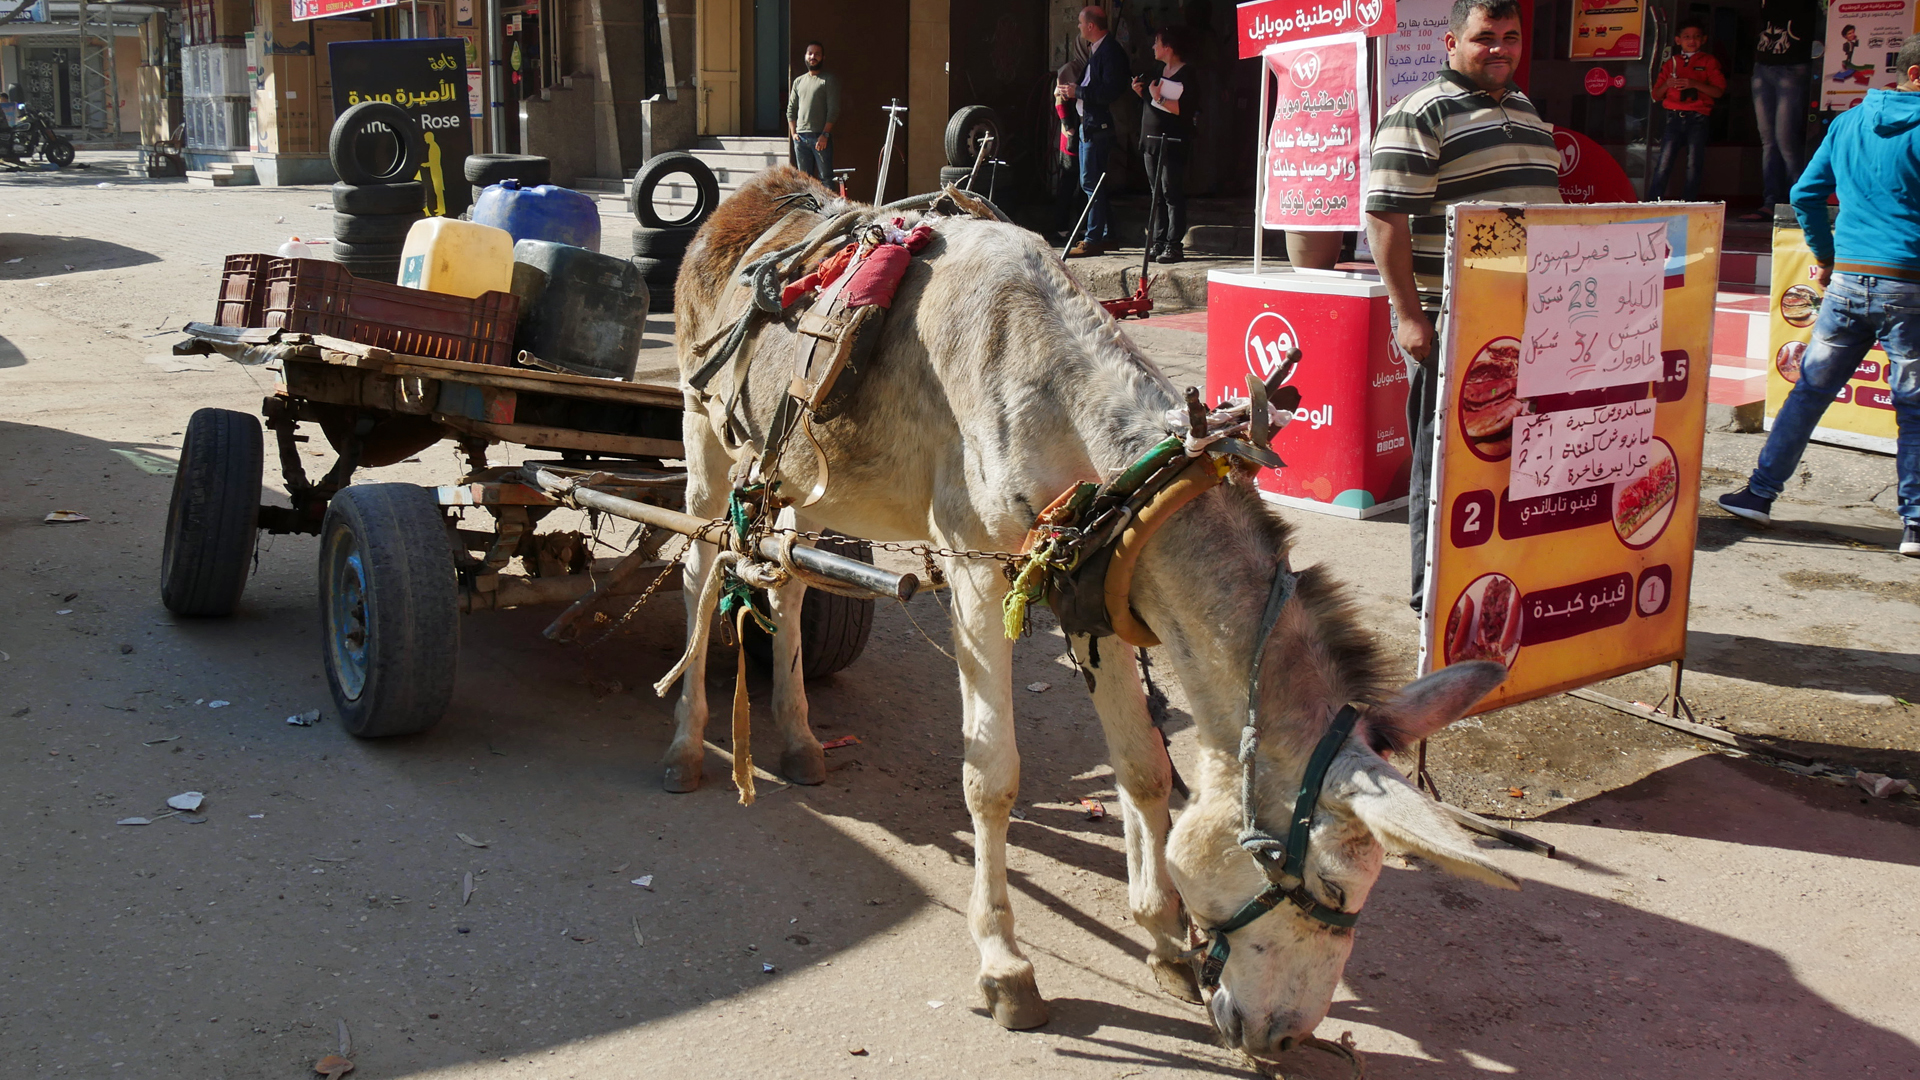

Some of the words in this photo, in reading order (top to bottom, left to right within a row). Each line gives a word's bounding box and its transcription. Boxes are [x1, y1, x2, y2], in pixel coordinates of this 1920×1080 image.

[1248, 15, 1294, 40] موبايل
[1296, 0, 1350, 32] الوطنية
[1409, 19, 1420, 28] بها
[1422, 16, 1448, 27] شريحة
[1400, 30, 1412, 38] MB
[1418, 29, 1432, 37] 100
[1388, 55, 1412, 66] هدية
[1396, 44, 1410, 52] SMS
[1414, 54, 1436, 66] على
[428, 53, 457, 71] قاعة
[1391, 71, 1418, 86] شيكل
[395, 79, 456, 109] الأميرة
[1302, 90, 1355, 117] الوطنية
[421, 114, 460, 130] Rose
[1274, 128, 1295, 153] علينا
[1296, 124, 1352, 153] الشريحة
[1272, 158, 1298, 182] عليك
[1300, 156, 1356, 182] والرصيد
[1280, 189, 1304, 216] نوكيا
[1306, 188, 1348, 217] معرض
[1614, 222, 1666, 266] كباب
[1532, 285, 1564, 314] شيكل
[1568, 277, 1598, 312] 28
[1615, 275, 1658, 315] الكيلو
[1525, 328, 1559, 364] شيكل
[1608, 315, 1659, 351] شيش
[1603, 340, 1656, 372] طاووك
[1373, 372, 1394, 388] موبايل
[1873, 393, 1892, 405] فتة
[1566, 406, 1608, 432] كبدة
[1376, 427, 1394, 440] تابعونا
[1568, 458, 1604, 486] فاخرة
[1520, 495, 1567, 526] تايلاندي
[1570, 490, 1598, 515] فينو
[1463, 502, 1481, 533] 2
[1533, 592, 1584, 618] كبدة
[1589, 579, 1626, 608] فينو
[1647, 581, 1657, 603] 1
